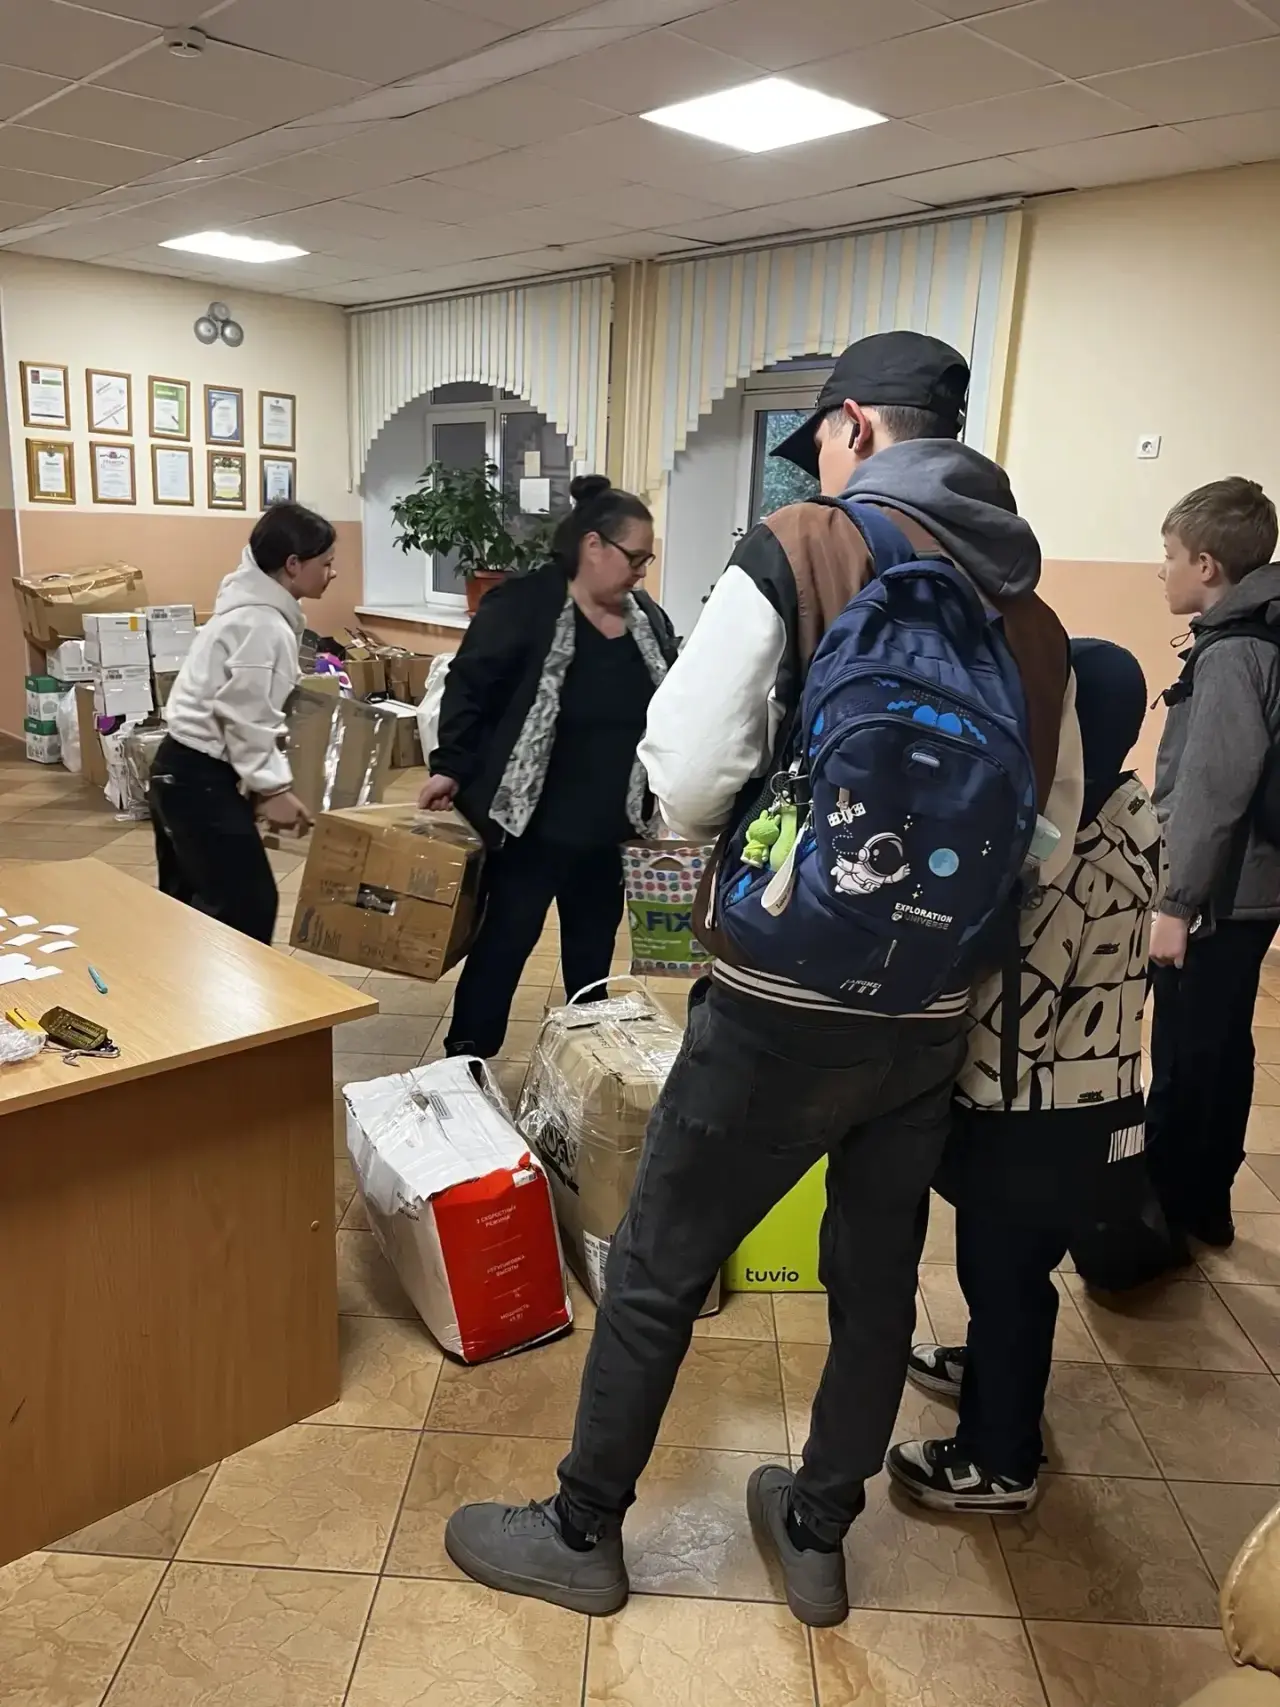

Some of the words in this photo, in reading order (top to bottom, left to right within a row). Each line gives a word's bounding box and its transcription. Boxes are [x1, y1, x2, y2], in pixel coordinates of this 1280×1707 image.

[894, 902, 953, 923] EXPLORATION
[904, 912, 950, 930] UNIVERSE
[745, 1266, 799, 1282] tuvio
